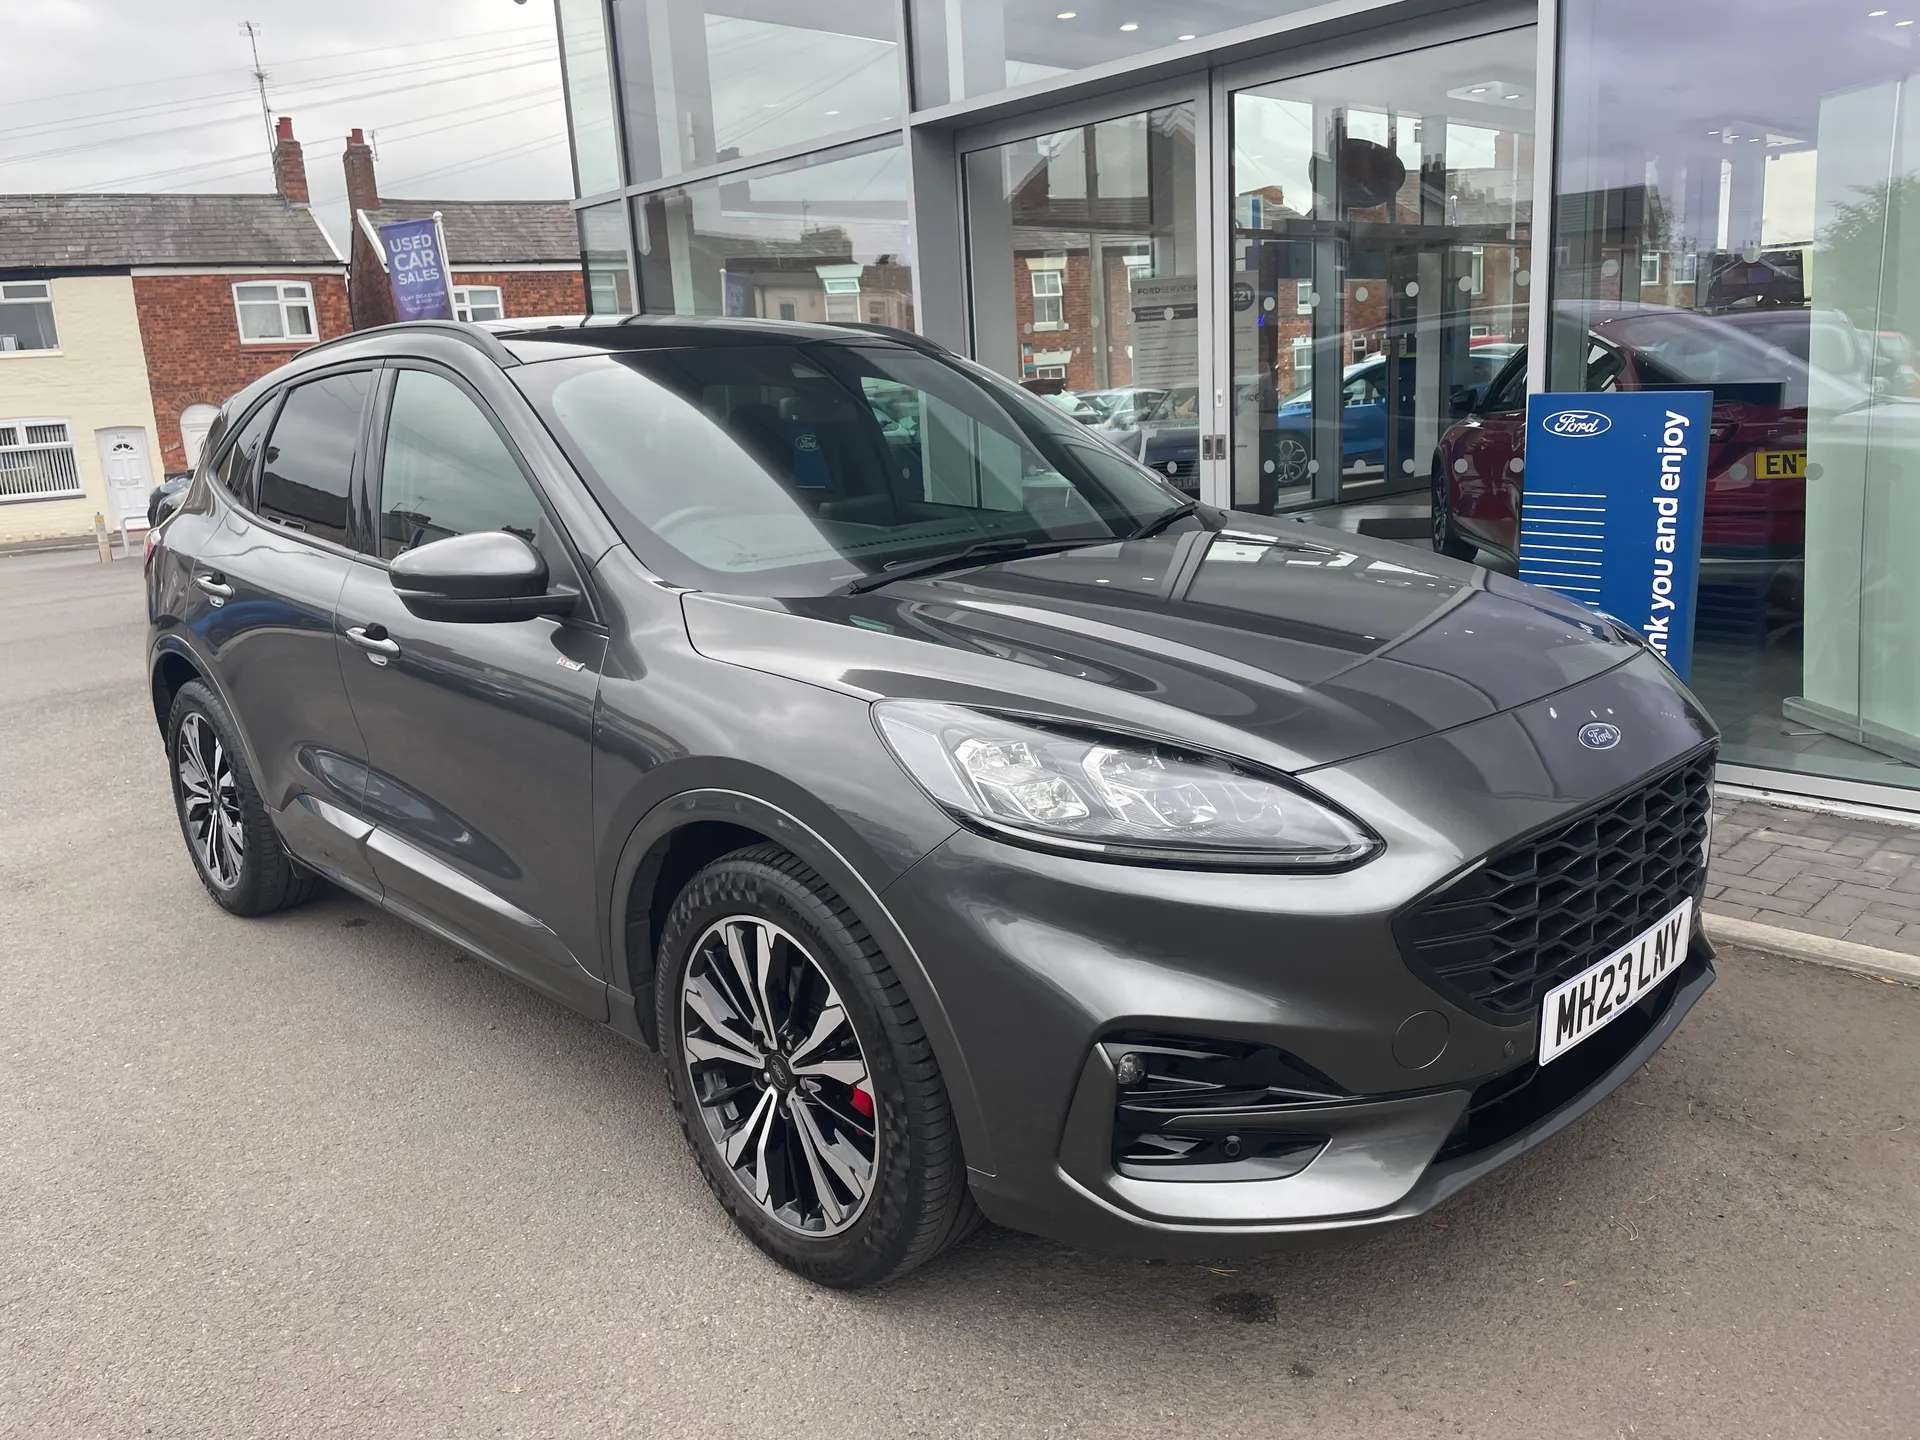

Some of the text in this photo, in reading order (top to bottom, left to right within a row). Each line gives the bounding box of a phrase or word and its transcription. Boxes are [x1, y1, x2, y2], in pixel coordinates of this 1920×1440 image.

[389, 234, 432, 252] USED
[394, 249, 435, 271] CAR
[398, 268, 440, 285] SALES
[1553, 413, 1600, 433] Ford
[1643, 410, 1690, 657] nk you and enjoy
[1587, 728, 1613, 745] Ford
[1555, 911, 1683, 1047] MH23 LNY
